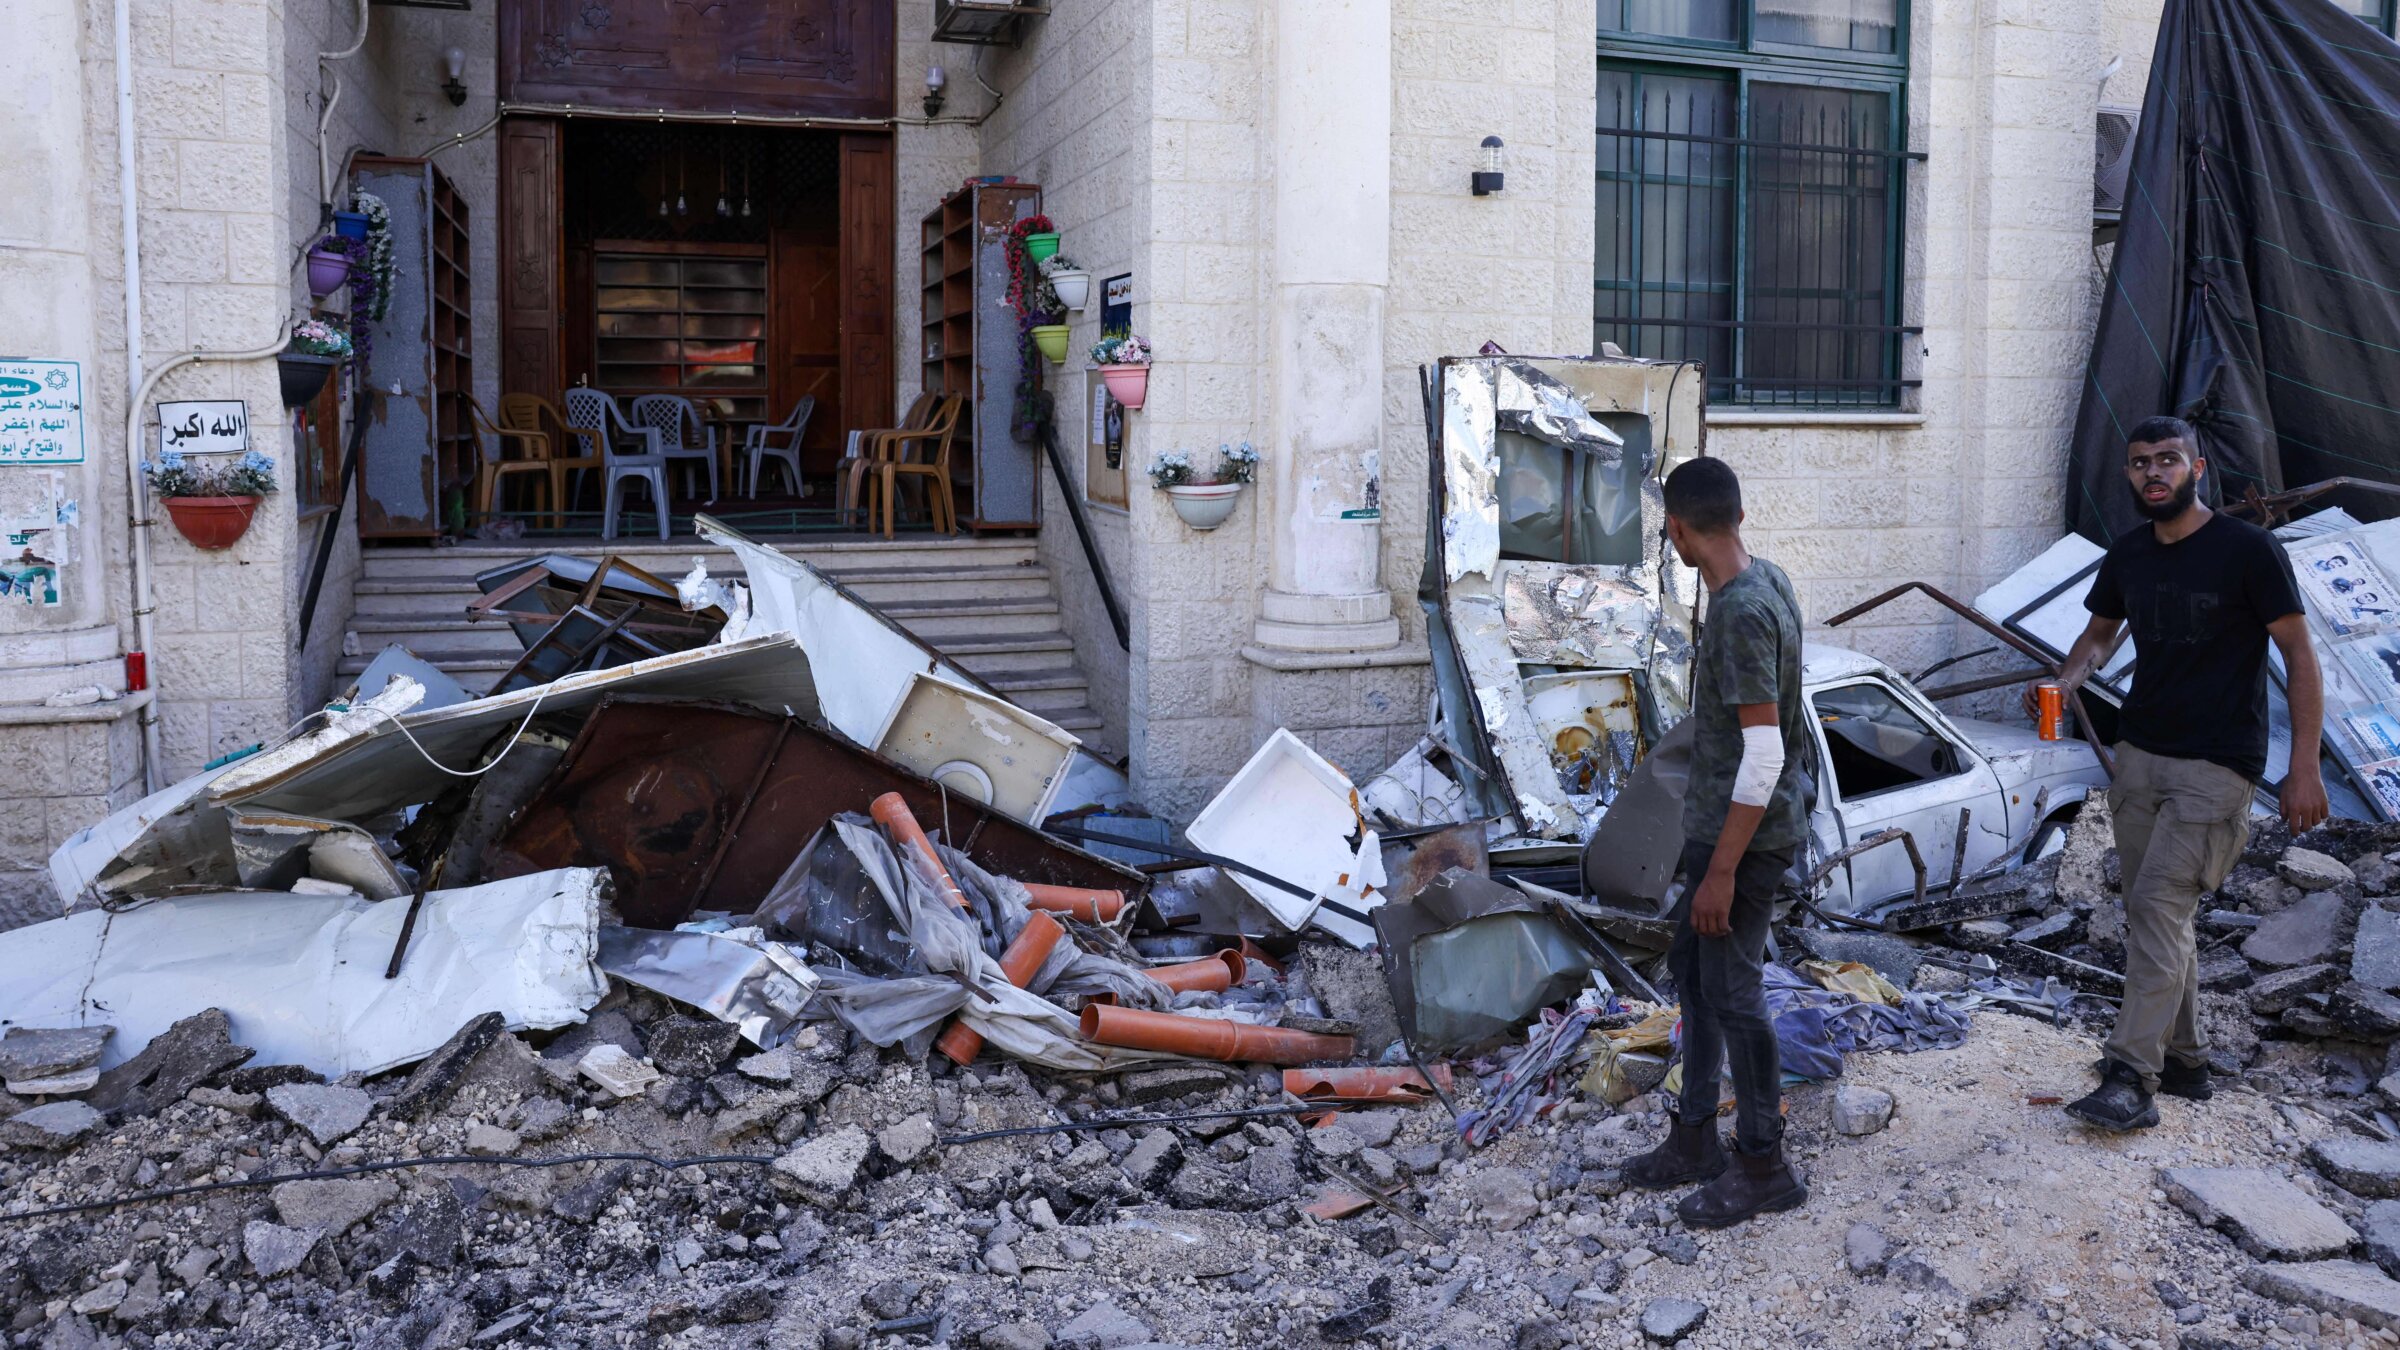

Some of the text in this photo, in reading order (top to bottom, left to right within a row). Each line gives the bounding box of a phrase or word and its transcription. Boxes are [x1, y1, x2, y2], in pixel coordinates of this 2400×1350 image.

[12, 367, 35, 375] دعاء
[28, 399, 75, 413] والسلام
[166, 412, 242, 448] الله اكبر
